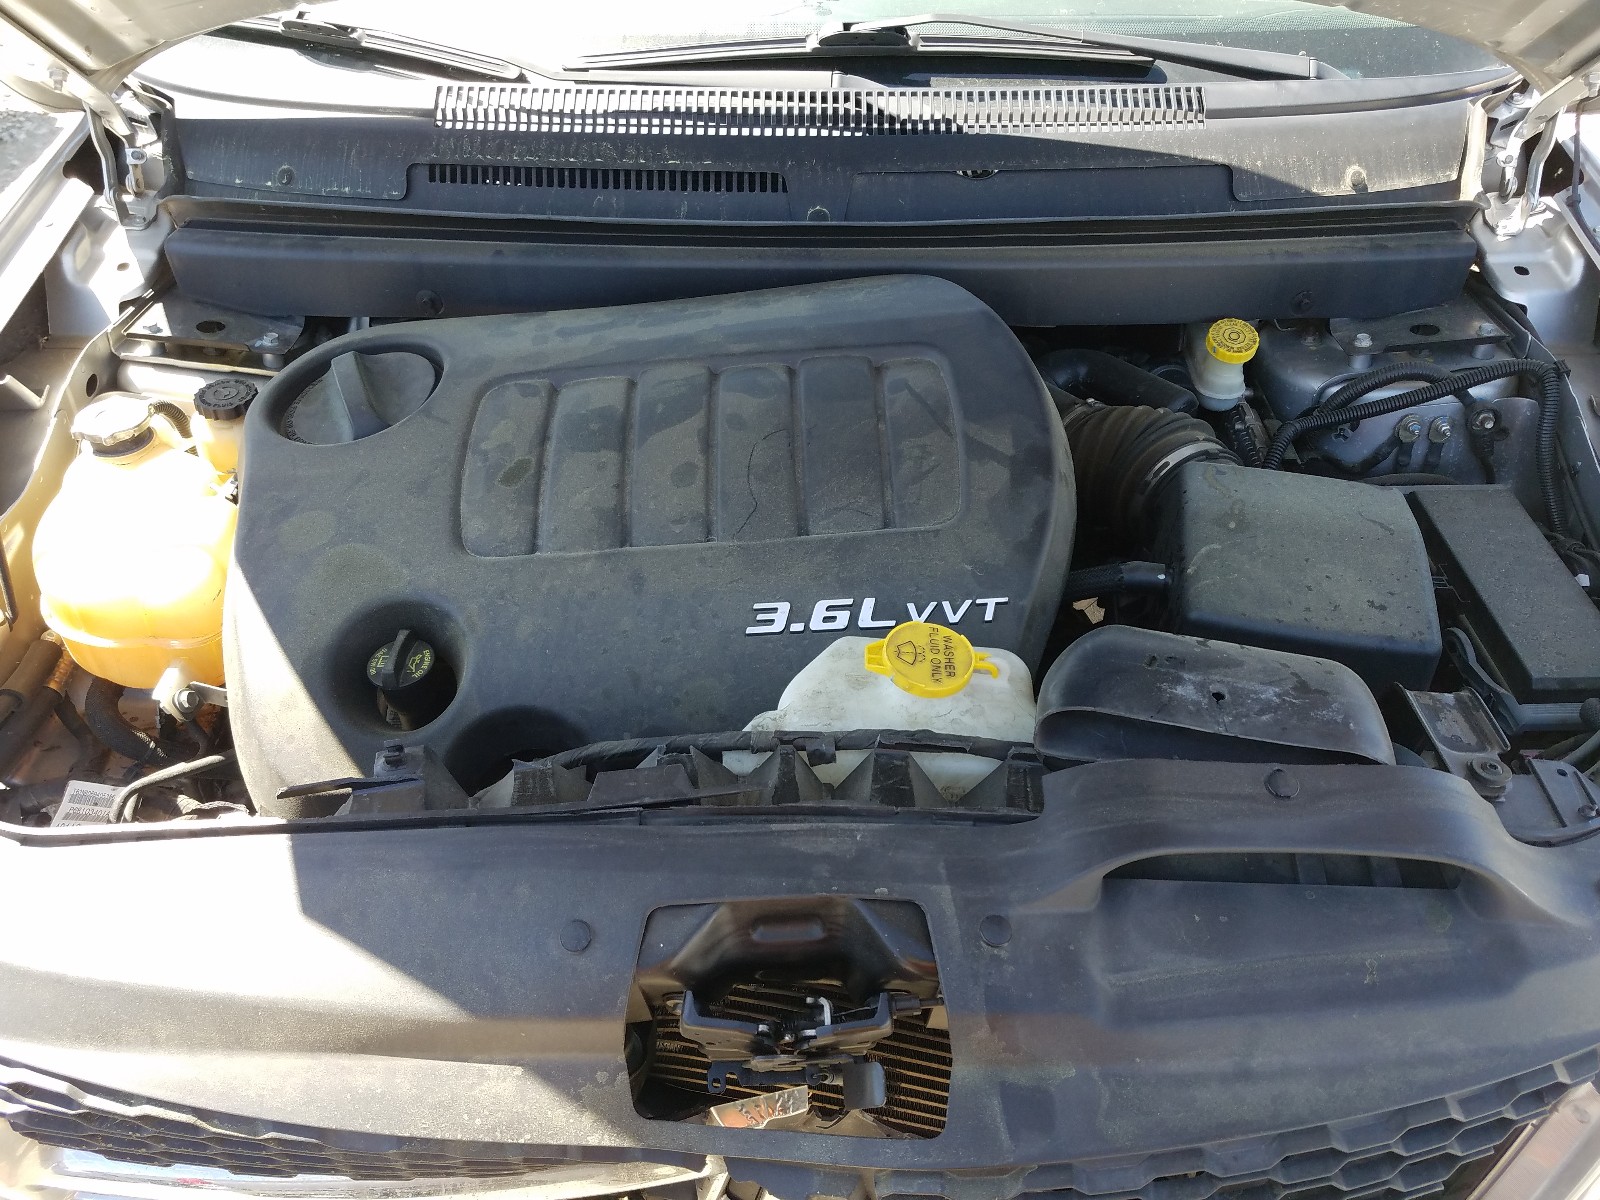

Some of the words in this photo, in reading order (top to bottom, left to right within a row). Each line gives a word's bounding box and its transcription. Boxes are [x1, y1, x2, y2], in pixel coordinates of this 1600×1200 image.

[745, 597, 896, 635] 3.6L
[906, 597, 1009, 624] VVT
[928, 626, 941, 655] FLUID
[422, 649, 431, 669] ENGINE
[930, 657, 943, 684] ONLY
[942, 635, 956, 678] WASHER
[411, 669, 424, 678] OIL
